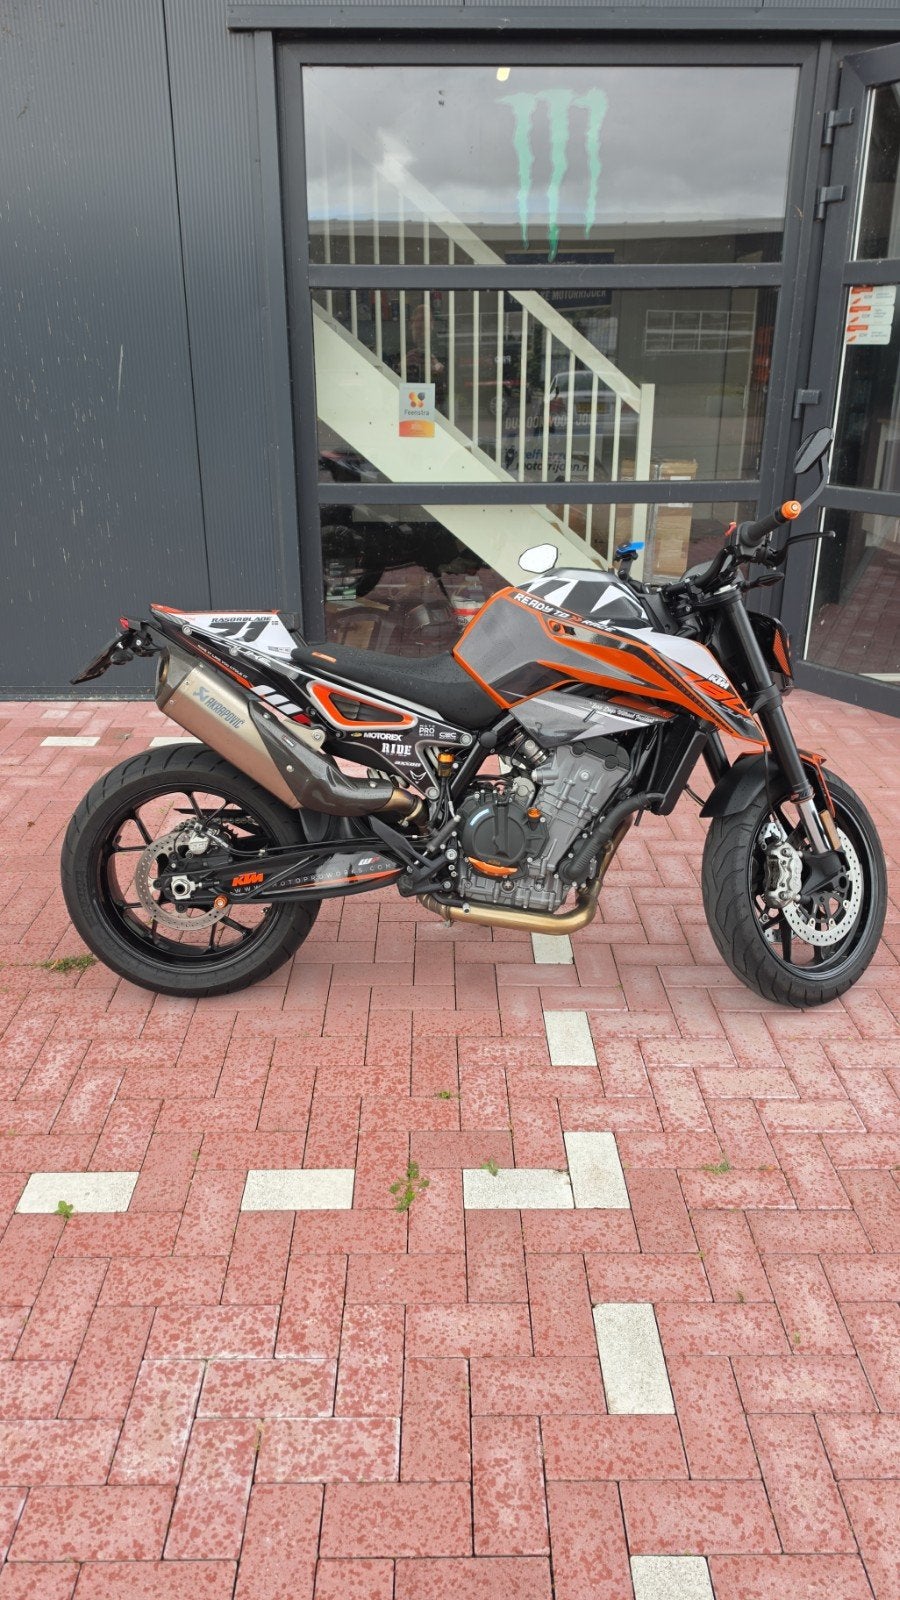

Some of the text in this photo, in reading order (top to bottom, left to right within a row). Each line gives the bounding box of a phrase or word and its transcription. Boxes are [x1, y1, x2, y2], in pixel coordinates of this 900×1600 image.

[513, 593, 554, 613] READY
[552, 609, 571, 619] TO
[707, 674, 730, 690] KTM
[363, 732, 404, 742] MOTOREX
[381, 742, 412, 755] RIDE
[231, 872, 264, 887] KTM
